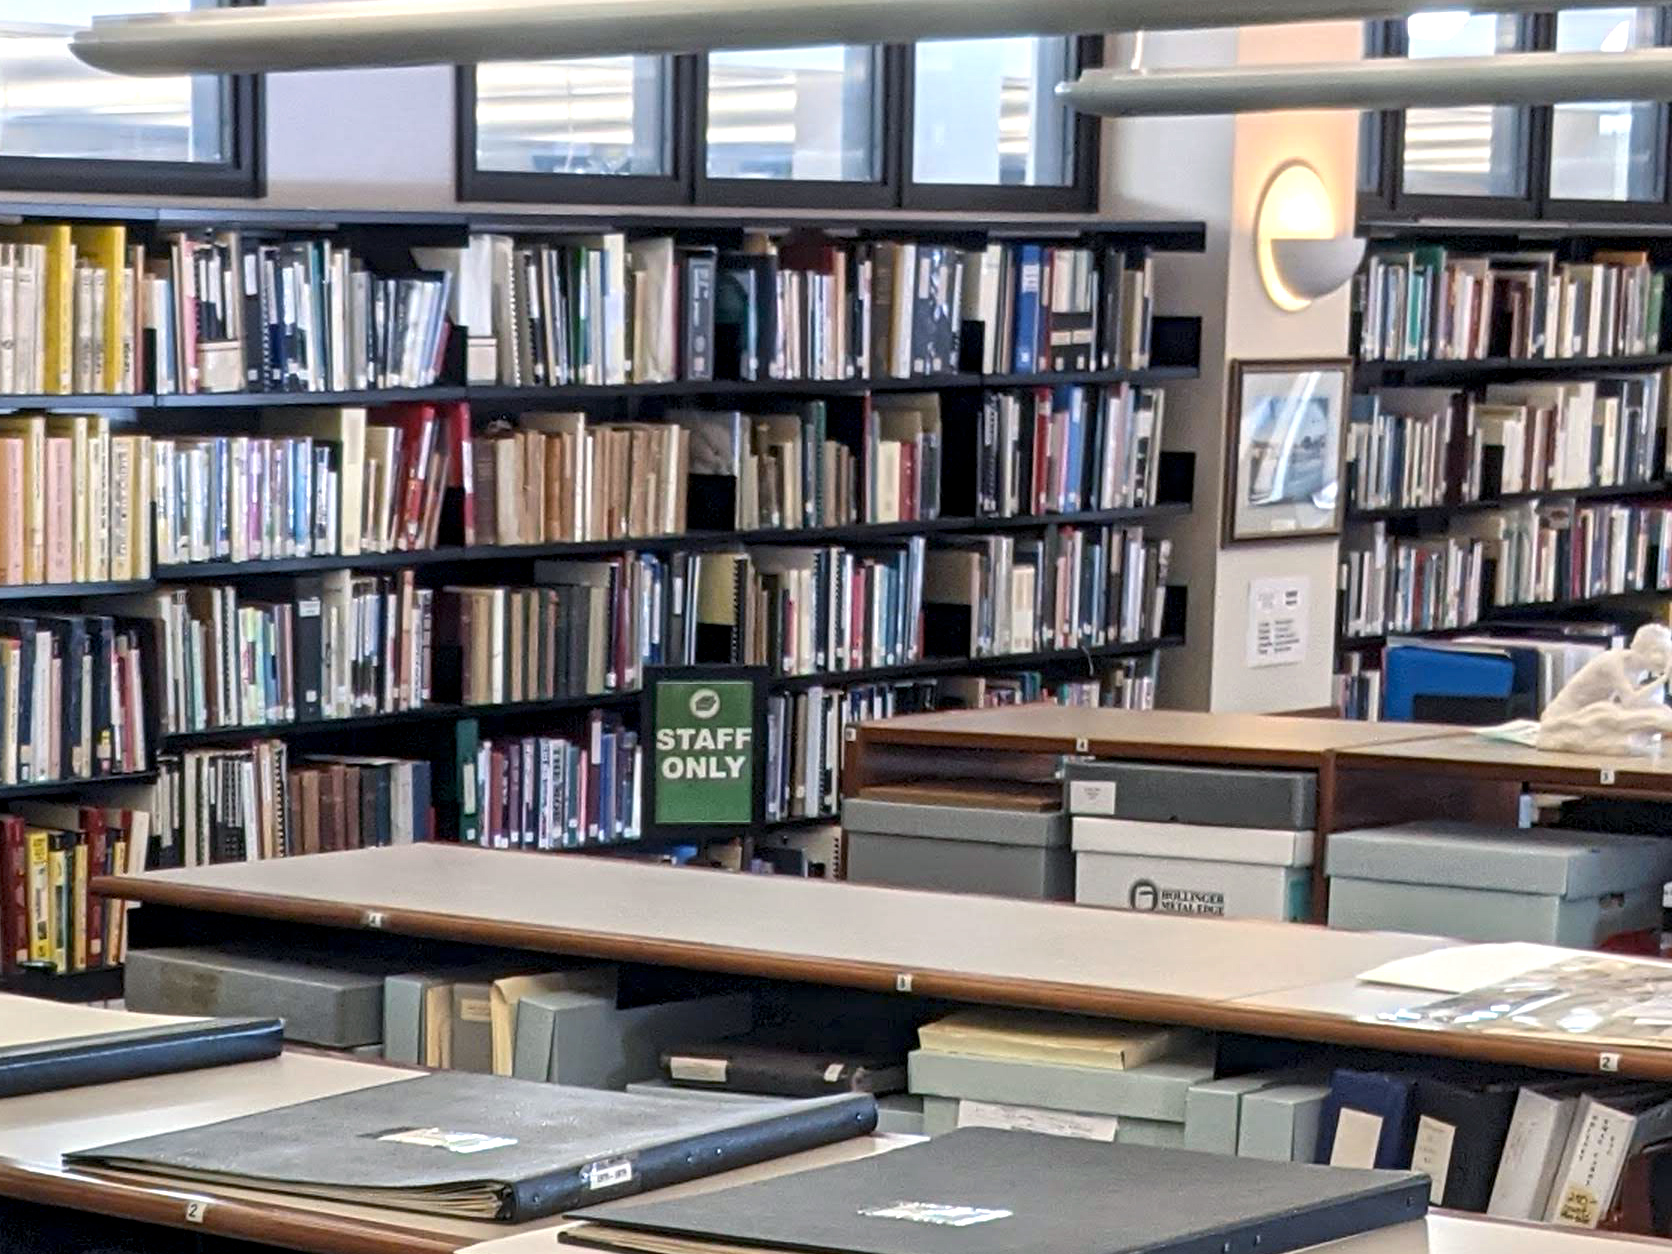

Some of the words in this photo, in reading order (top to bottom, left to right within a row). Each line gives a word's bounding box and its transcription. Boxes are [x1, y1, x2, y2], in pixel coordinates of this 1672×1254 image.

[656, 727, 752, 751] STAFF
[661, 756, 747, 780] ONLY
[1161, 889, 1225, 904] HOLLINGER
[1161, 900, 1195, 913] METAL
[1196, 903, 1225, 916] EDGE
[1601, 1056, 1611, 1069] 2
[188, 1203, 198, 1218] 2
